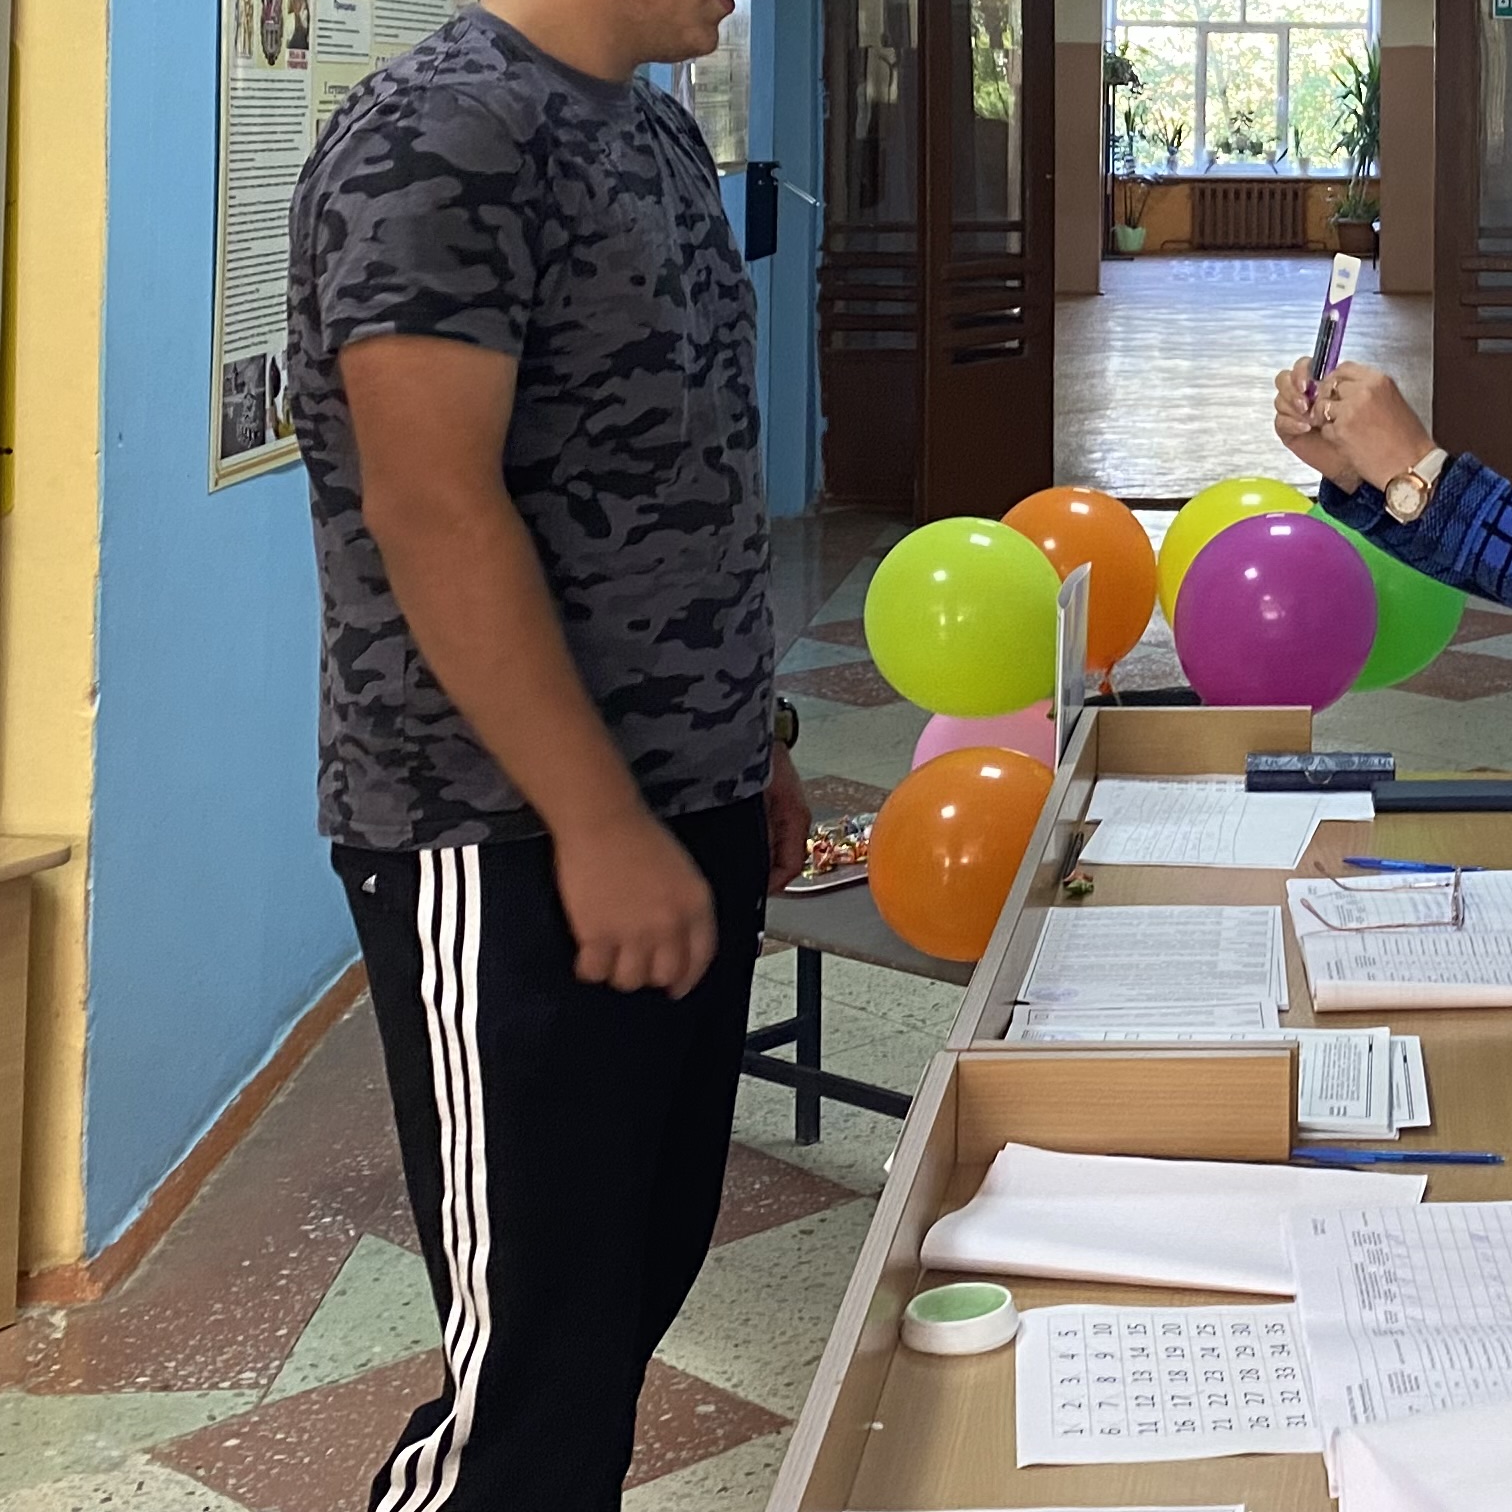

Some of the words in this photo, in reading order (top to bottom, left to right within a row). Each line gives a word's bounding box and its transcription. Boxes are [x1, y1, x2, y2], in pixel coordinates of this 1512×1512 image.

[1093, 1323, 1112, 1336] 10
[1127, 1323, 1147, 1336] 15
[1162, 1323, 1182, 1336] 20
[1196, 1324, 1216, 1336] 25
[1231, 1323, 1251, 1337] 30
[1265, 1323, 1285, 1335] 35
[1129, 1347, 1150, 1359] 14
[1165, 1346, 1185, 1359] 19
[1200, 1347, 1220, 1360] 24
[1235, 1345, 1255, 1359] 29
[1270, 1344, 1291, 1357] 34
[1132, 1370, 1152, 1383] 13
[1168, 1370, 1188, 1383] 18
[1204, 1370, 1224, 1383] 23
[1239, 1368, 1260, 1381] 28
[1275, 1367, 1296, 1380] 33
[1134, 1394, 1155, 1408] 12
[1171, 1395, 1192, 1408] 17
[1207, 1393, 1228, 1406] 22
[1244, 1392, 1265, 1405] 27
[1280, 1390, 1301, 1404] 32
[1137, 1420, 1158, 1433] 11
[1174, 1419, 1195, 1433] 16
[1212, 1418, 1233, 1431] 21
[1248, 1416, 1270, 1429] 26
[1286, 1413, 1307, 1427] 31
